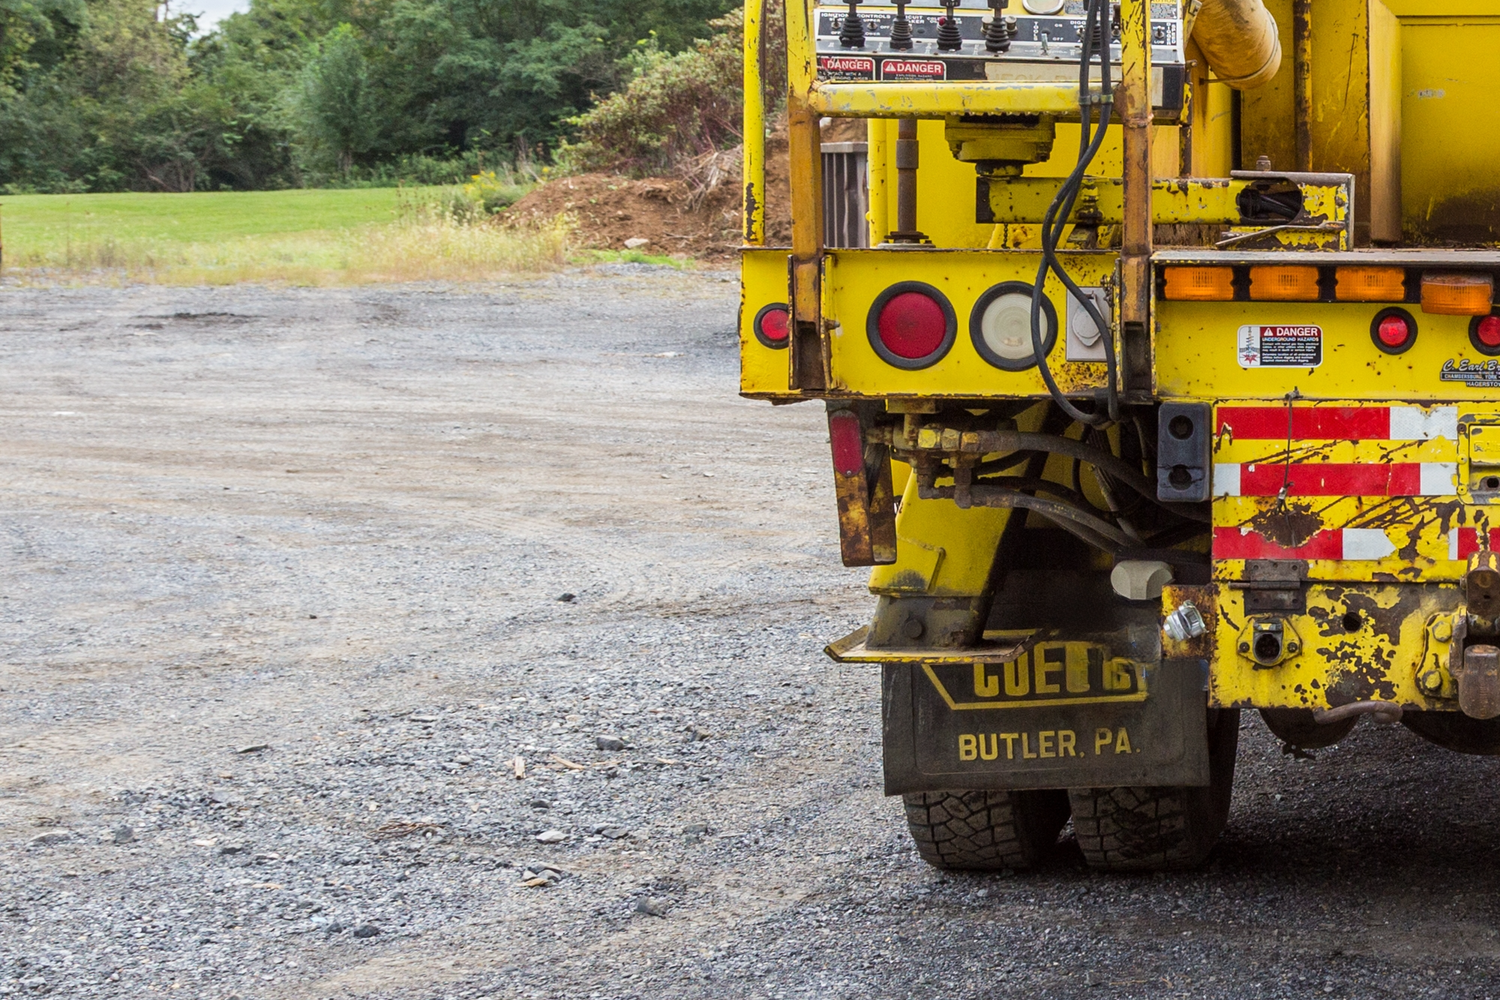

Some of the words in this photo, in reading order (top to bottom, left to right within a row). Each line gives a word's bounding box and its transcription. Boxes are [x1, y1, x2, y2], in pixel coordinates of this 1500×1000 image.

[827, 60, 871, 70] DANGER
[897, 63, 942, 73] DANGER
[1276, 327, 1318, 336] DANGER
[1443, 359, 1454, 371] C.
[1458, 359, 1485, 371] Earl
[958, 729, 1085, 761] BUTLER,
[1094, 727, 1141, 755] PA.
